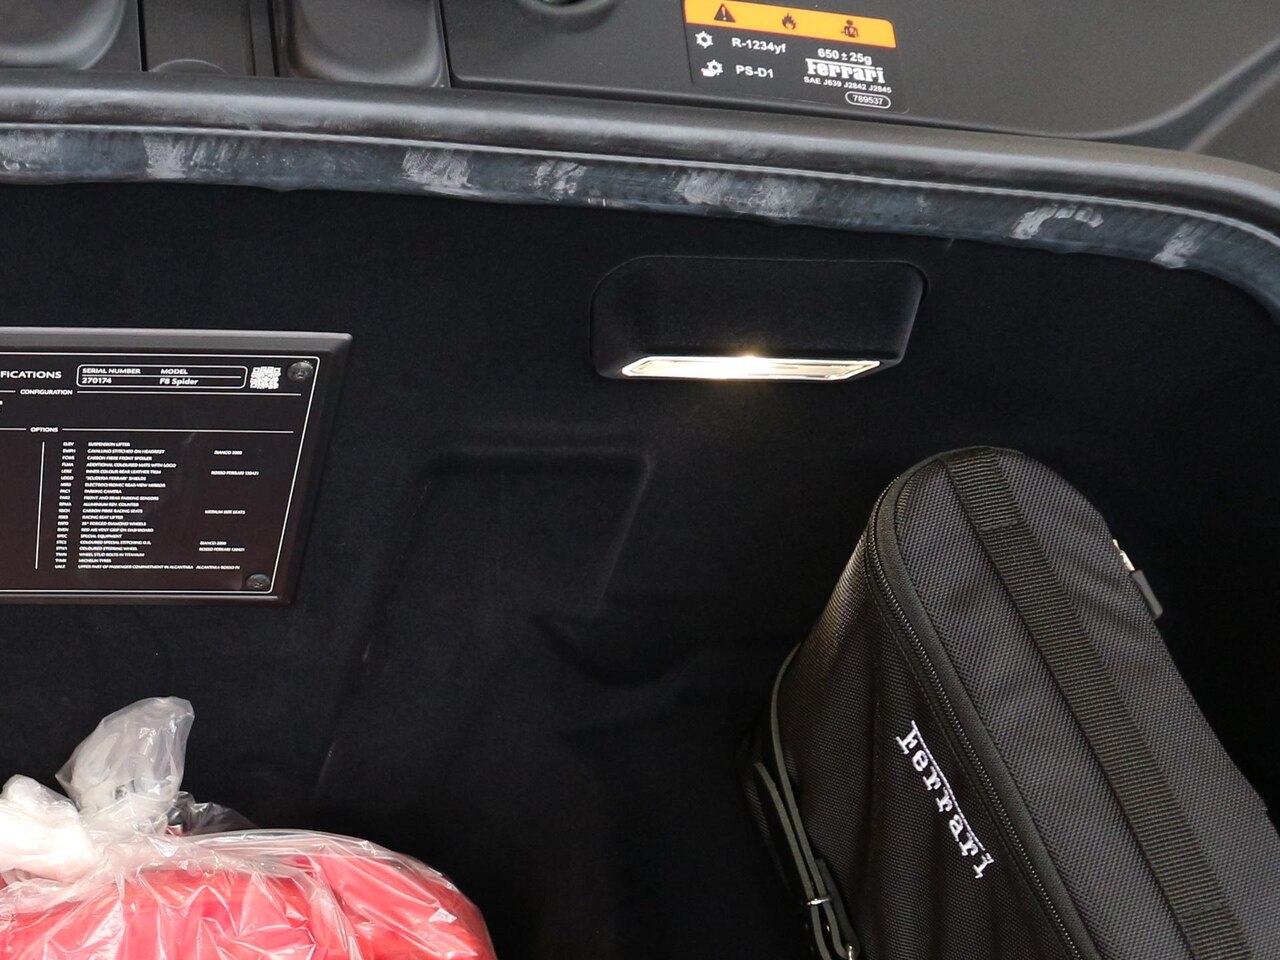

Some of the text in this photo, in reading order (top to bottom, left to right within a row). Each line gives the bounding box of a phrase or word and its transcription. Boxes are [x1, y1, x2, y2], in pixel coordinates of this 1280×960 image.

[732, 37, 786, 54] R-1234yf
[817, 48, 840, 60] 650
[849, 52, 872, 66] 25g
[735, 64, 774, 79] PS-D1
[805, 58, 886, 84] Ferrari
[803, 76, 822, 85] SAE
[823, 78, 842, 87] J639
[159, 377, 199, 386] F8 Spider
[895, 720, 994, 879] Ferrari
